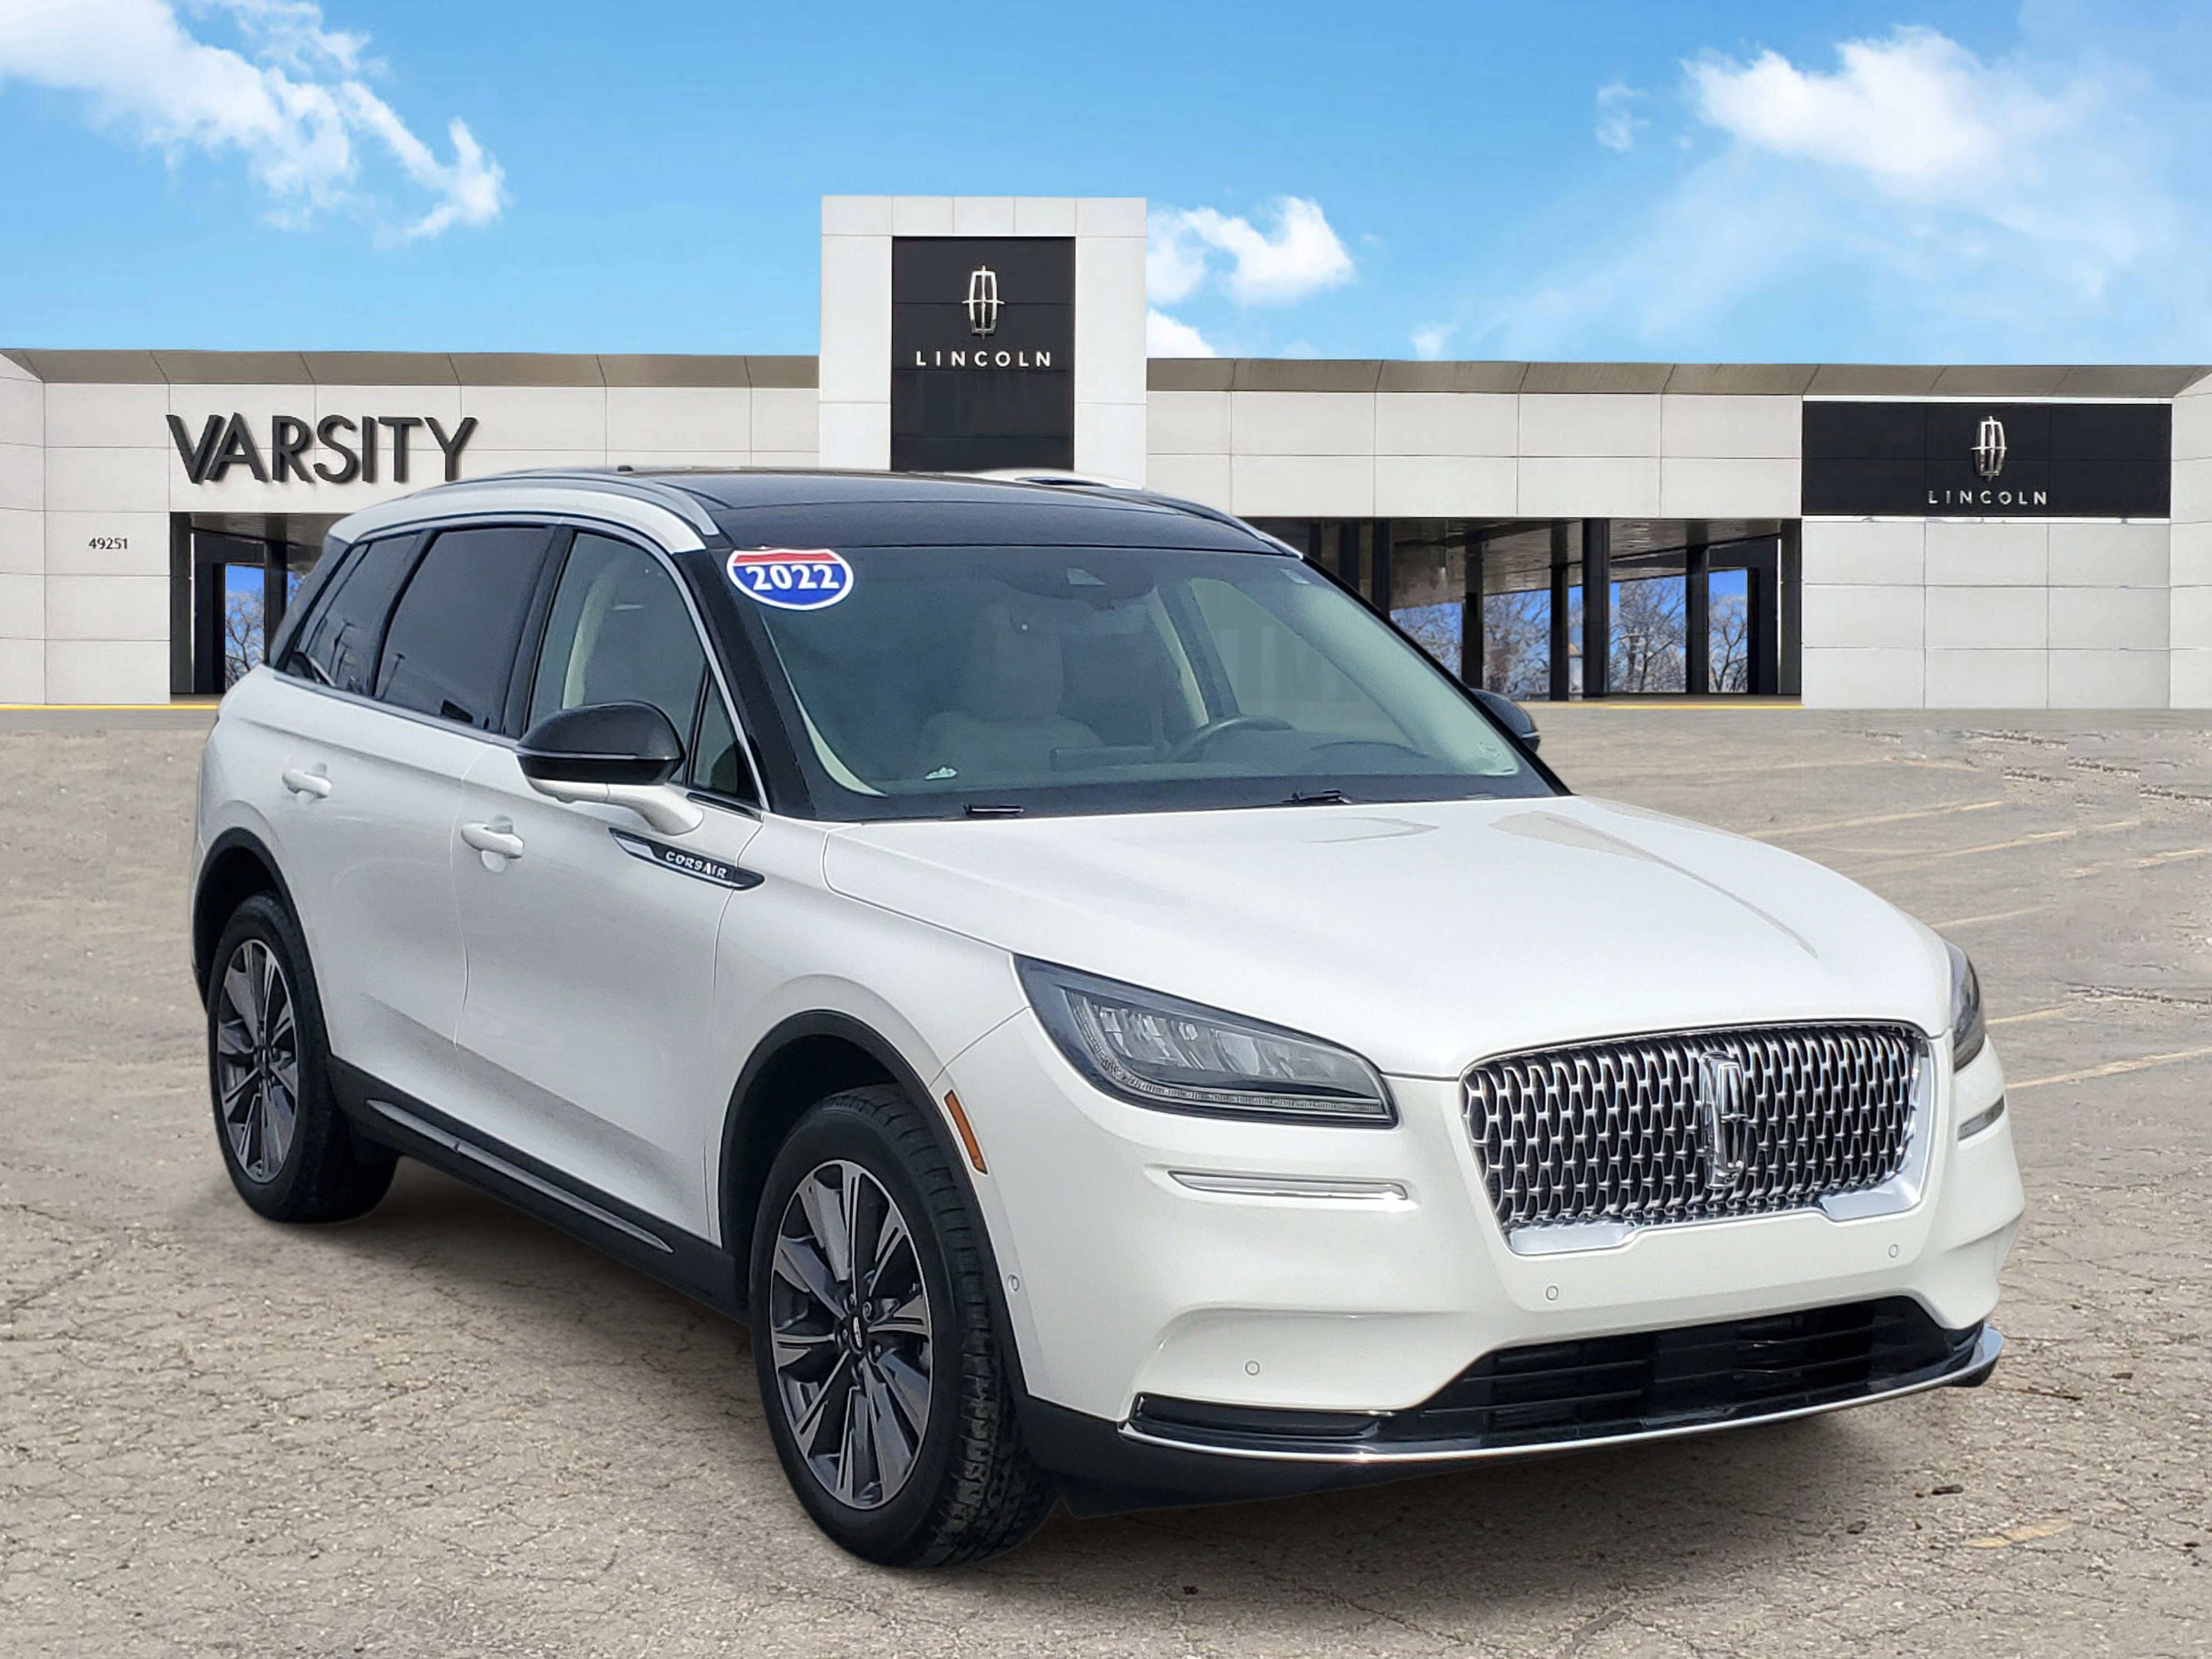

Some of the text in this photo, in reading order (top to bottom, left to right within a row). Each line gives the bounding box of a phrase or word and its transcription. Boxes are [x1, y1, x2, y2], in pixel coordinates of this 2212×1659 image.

[916, 351, 1051, 367] LINCOLN
[166, 413, 479, 484] VARSITY
[1928, 490, 2048, 505] LINCOLN
[89, 537, 129, 550] 49251
[745, 564, 840, 591] 2022
[665, 851, 727, 879] CORSAIR
